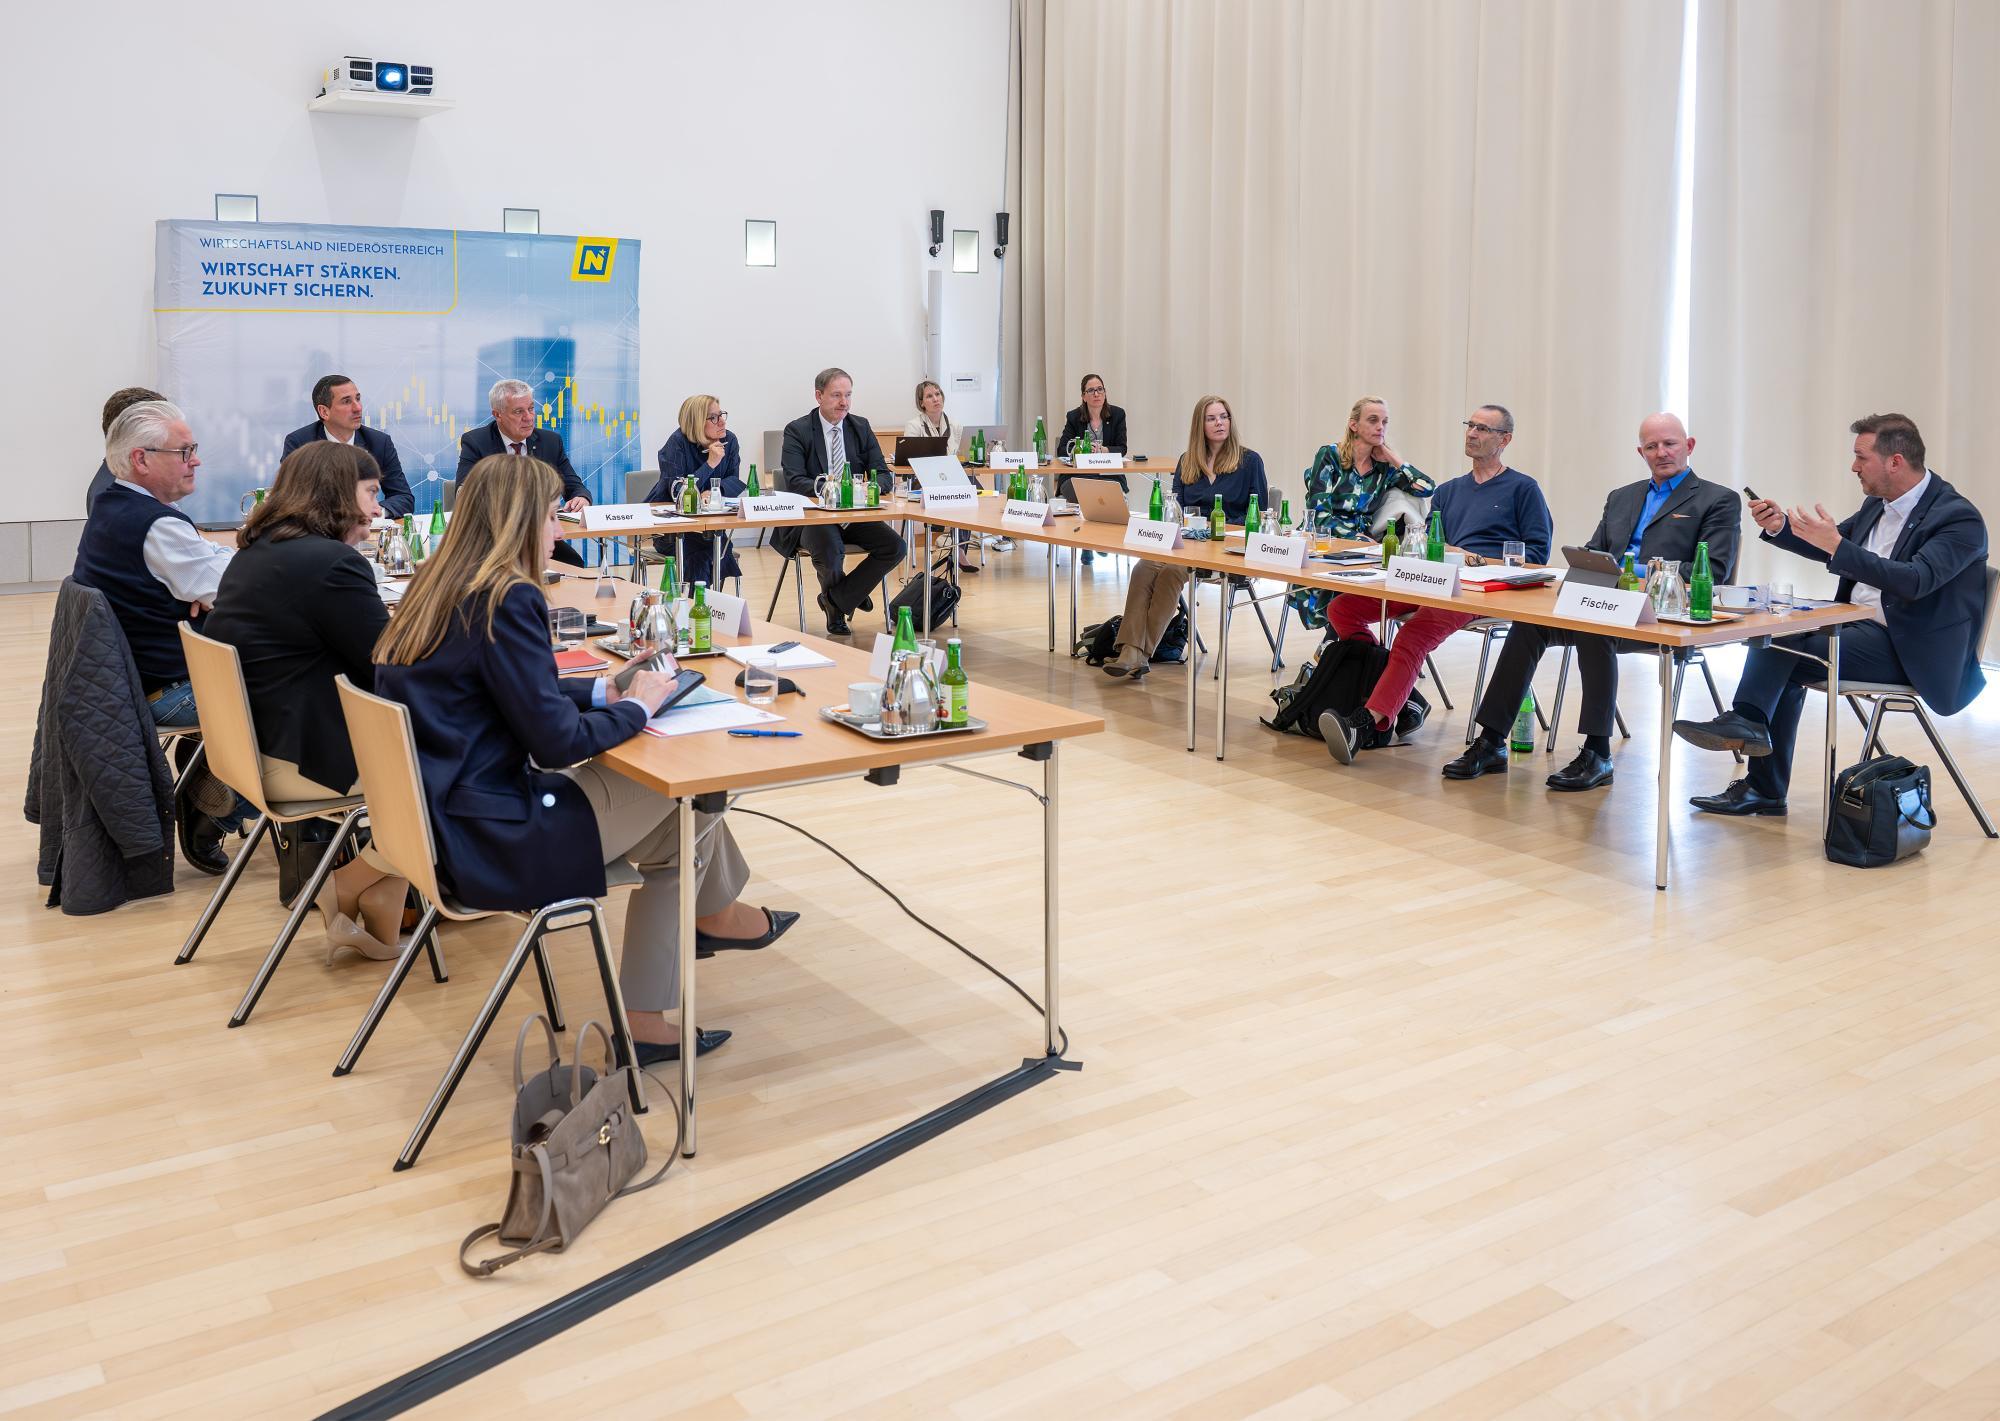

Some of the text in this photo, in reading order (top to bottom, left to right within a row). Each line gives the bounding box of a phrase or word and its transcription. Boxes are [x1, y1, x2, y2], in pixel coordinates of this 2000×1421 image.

[199, 237, 445, 256] WIRTSCHAFTSLAND NIEDERÖSTERREICH
[201, 261, 401, 281] WIRTSCHAFT STÄRKEN.
[202, 280, 374, 298] ZUKUNFT SICHERN.
[929, 492, 972, 502] Helmenstein
[753, 503, 795, 513] Mikl-Leitner
[605, 513, 634, 522] Kasser
[1137, 528, 1164, 542] Knieling
[1260, 543, 1290, 557] Greimel
[1394, 568, 1447, 586] Zeppelzauer
[1580, 596, 1619, 612] Fischer
